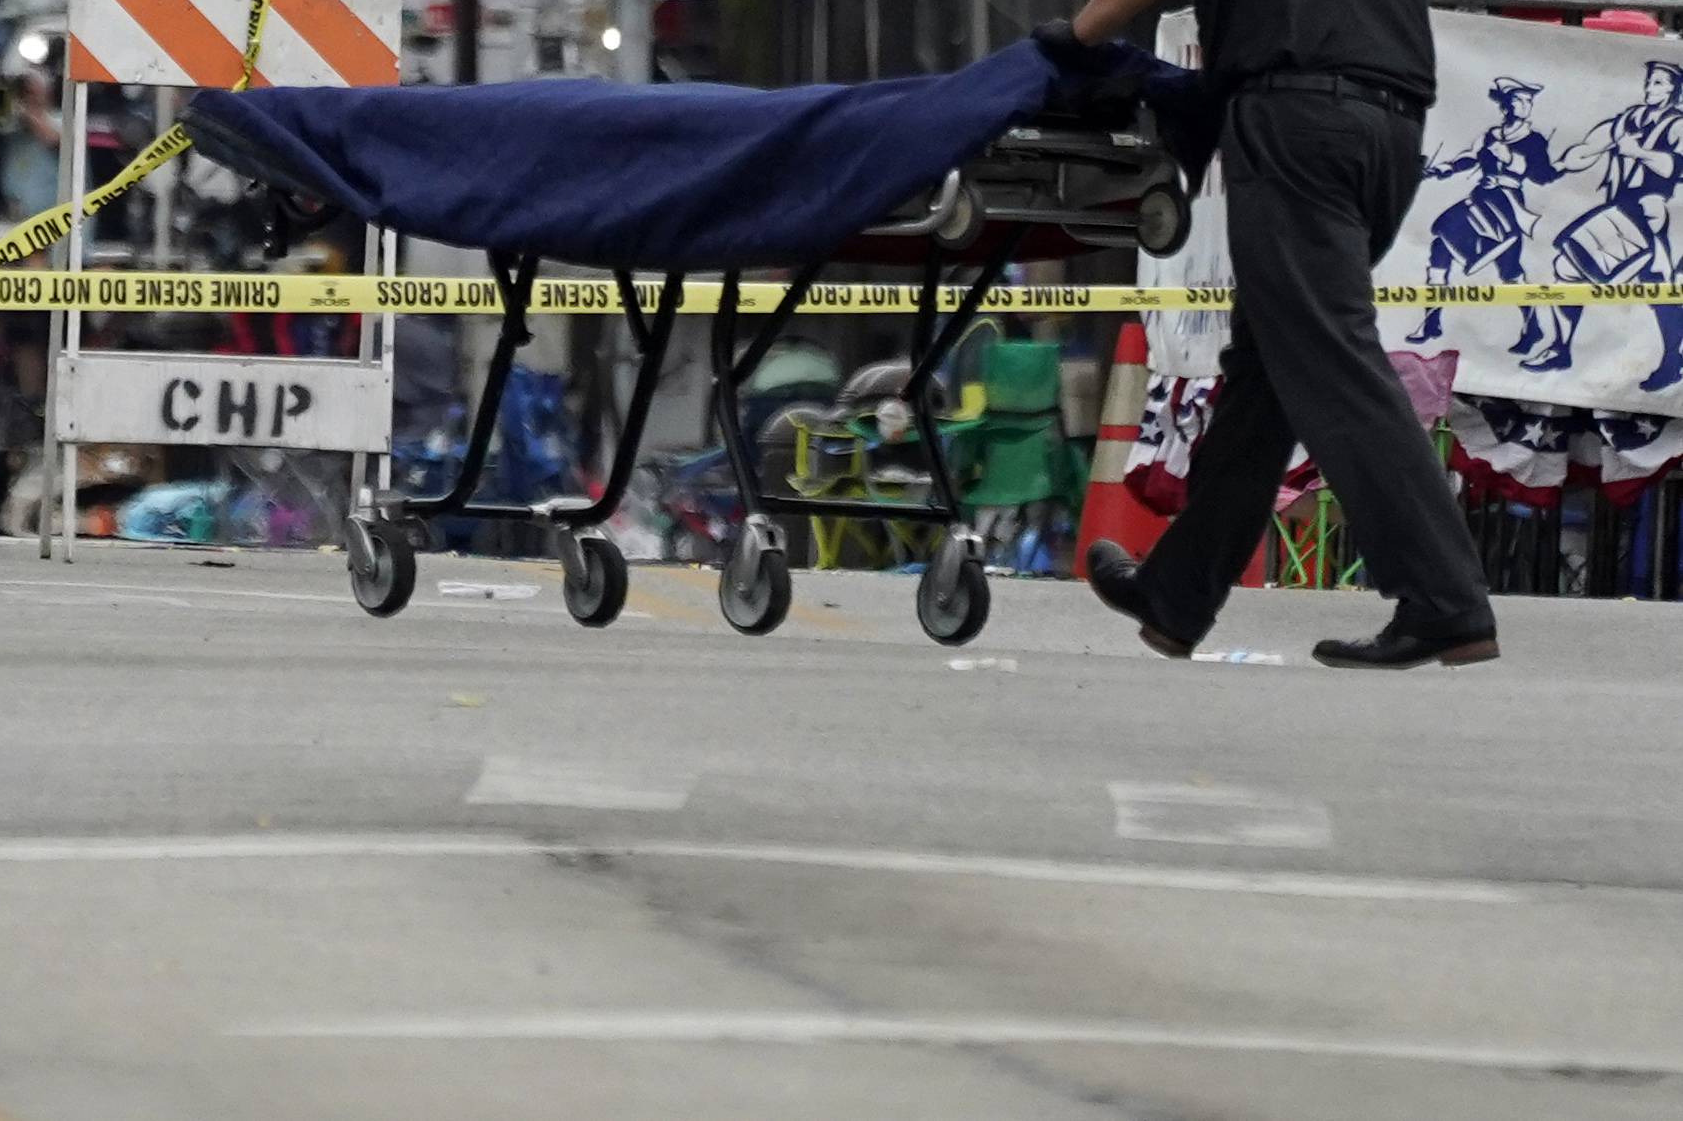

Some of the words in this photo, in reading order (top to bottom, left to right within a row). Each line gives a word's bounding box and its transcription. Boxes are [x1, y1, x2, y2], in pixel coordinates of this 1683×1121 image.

[24, 218, 61, 249] NOT
[48, 277, 90, 305] NOT
[99, 278, 127, 306] DO
[135, 279, 202, 307] SCENE
[210, 280, 281, 309] CRIME
[376, 279, 447, 307] CROSS
[453, 280, 496, 308] NOT
[539, 282, 608, 310] SCENE
[781, 284, 852, 309] CRO
[858, 286, 900, 308] NOT
[945, 287, 1014, 308] SCE
[1022, 287, 1091, 307] CRIME
[1373, 285, 1419, 303] SCE
[162, 377, 313, 438] CHP
